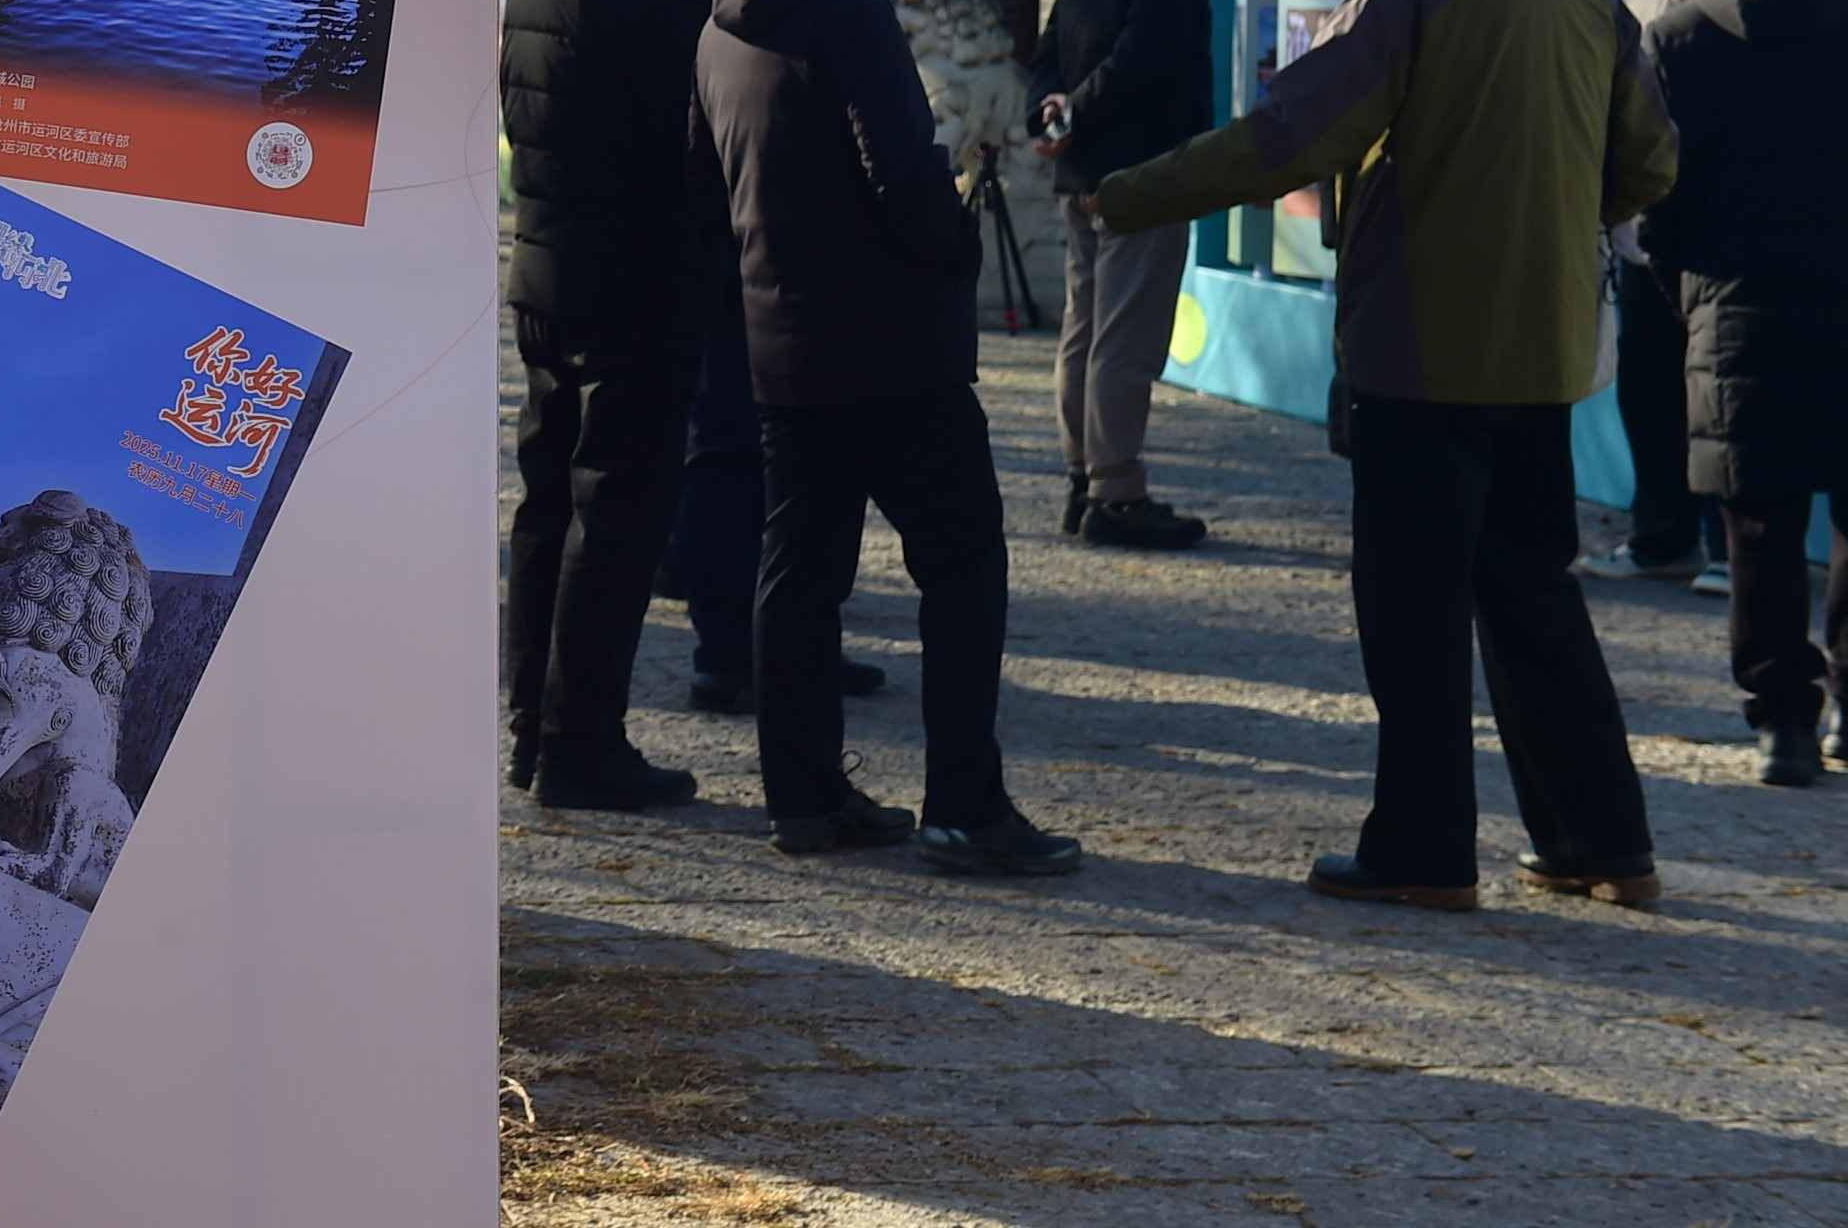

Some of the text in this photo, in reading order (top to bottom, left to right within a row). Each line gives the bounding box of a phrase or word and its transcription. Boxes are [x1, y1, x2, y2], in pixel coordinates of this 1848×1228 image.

[185, 325, 305, 409] 你好
[159, 379, 292, 478] 运河
[128, 461, 245, 530] 农历九月二十八
